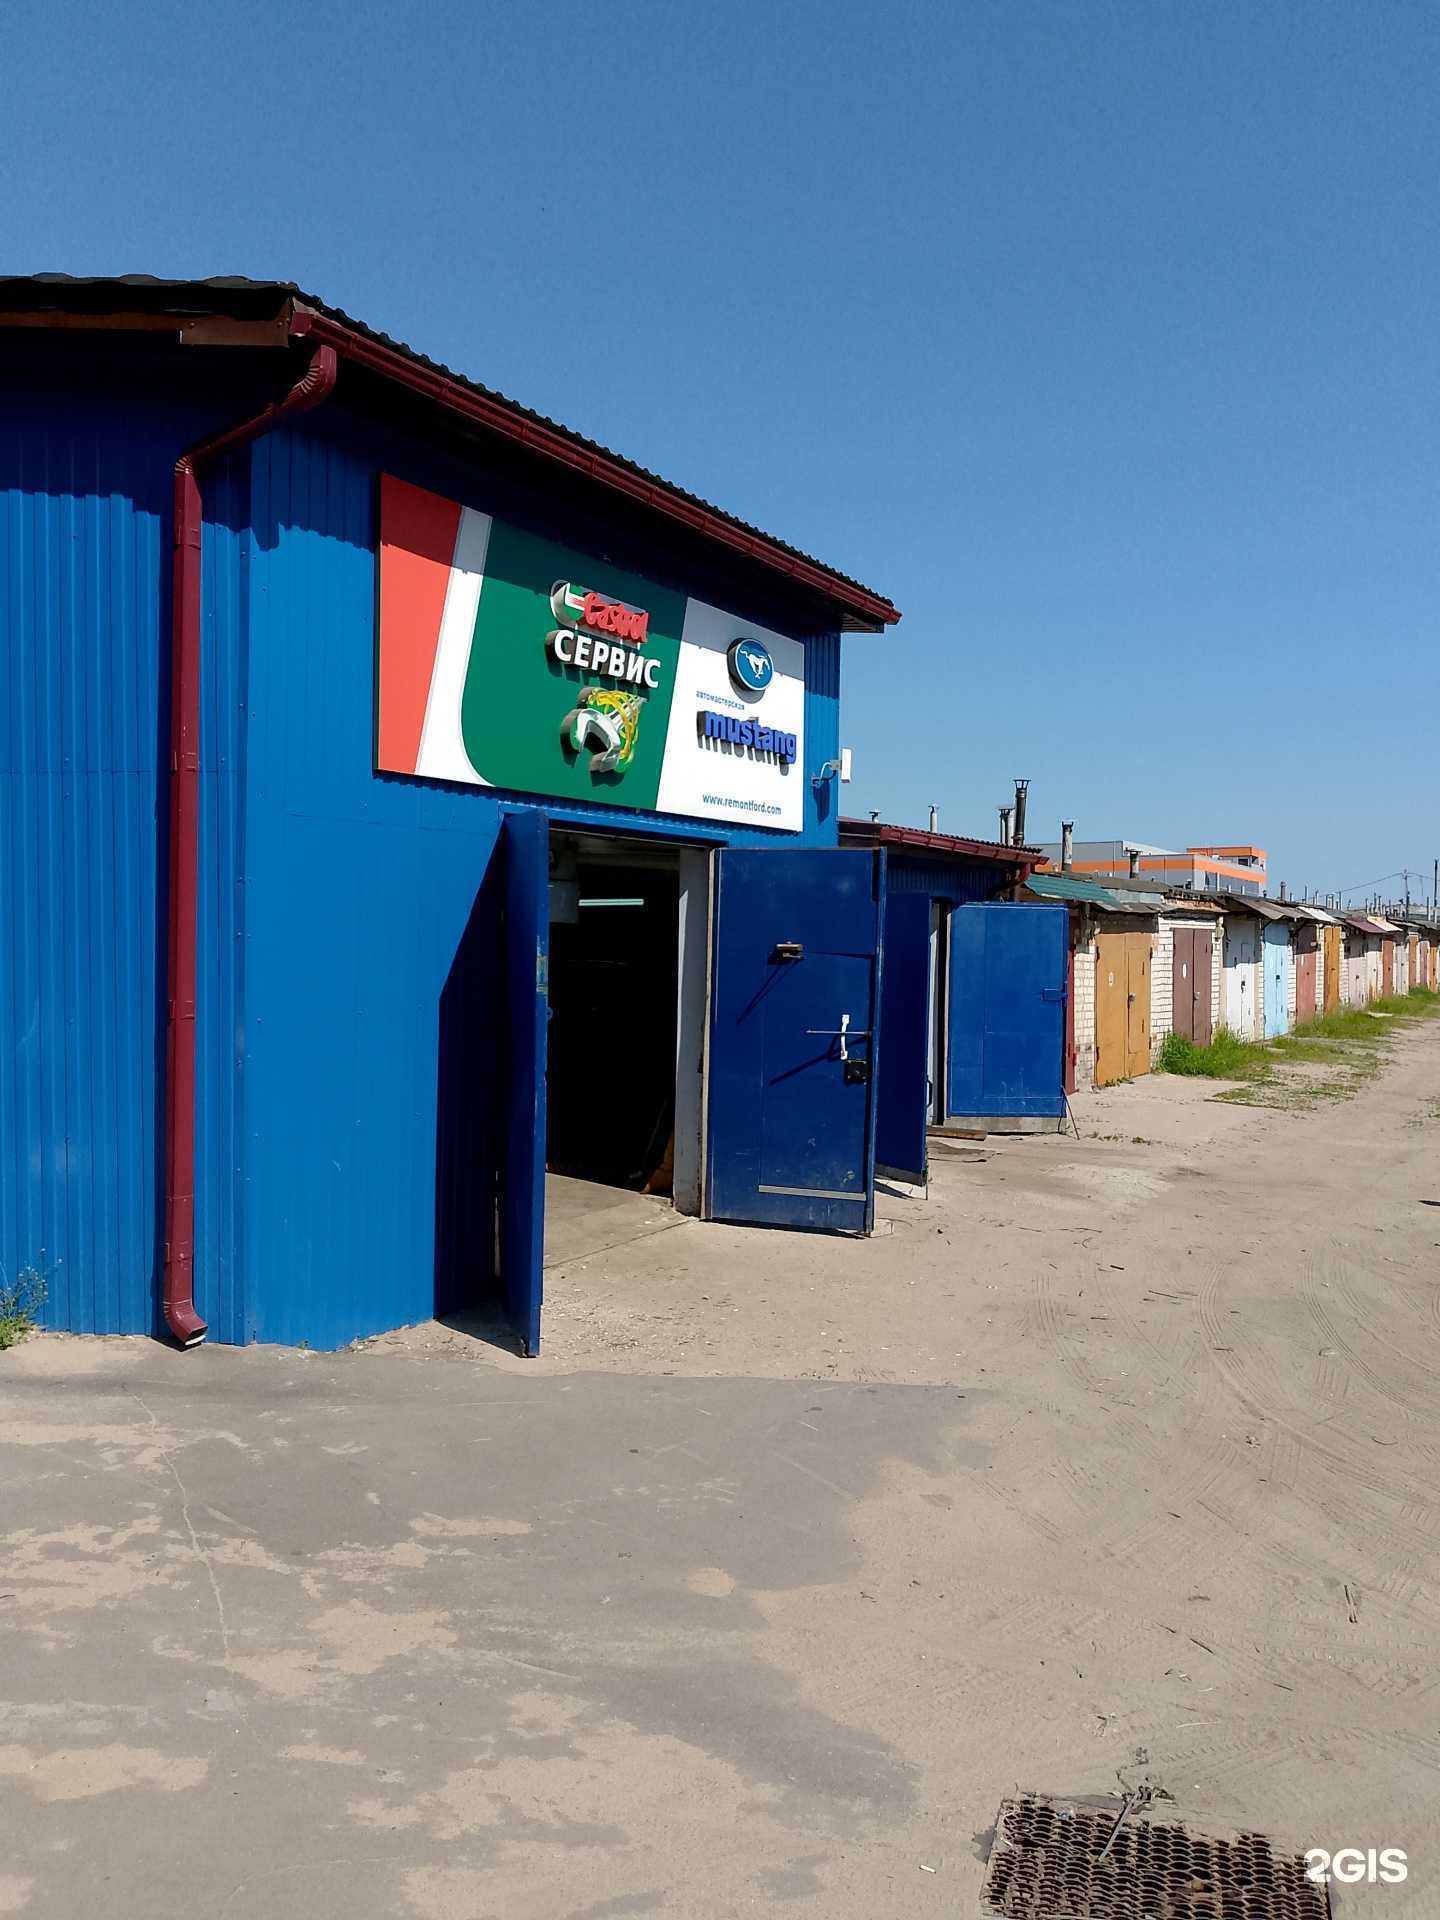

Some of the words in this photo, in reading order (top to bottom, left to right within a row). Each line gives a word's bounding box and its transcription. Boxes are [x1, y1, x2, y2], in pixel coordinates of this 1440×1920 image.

[554, 629, 661, 689] СЕРВИС
[704, 710, 797, 764] mustang
[702, 793, 782, 816] www.remontford.com
